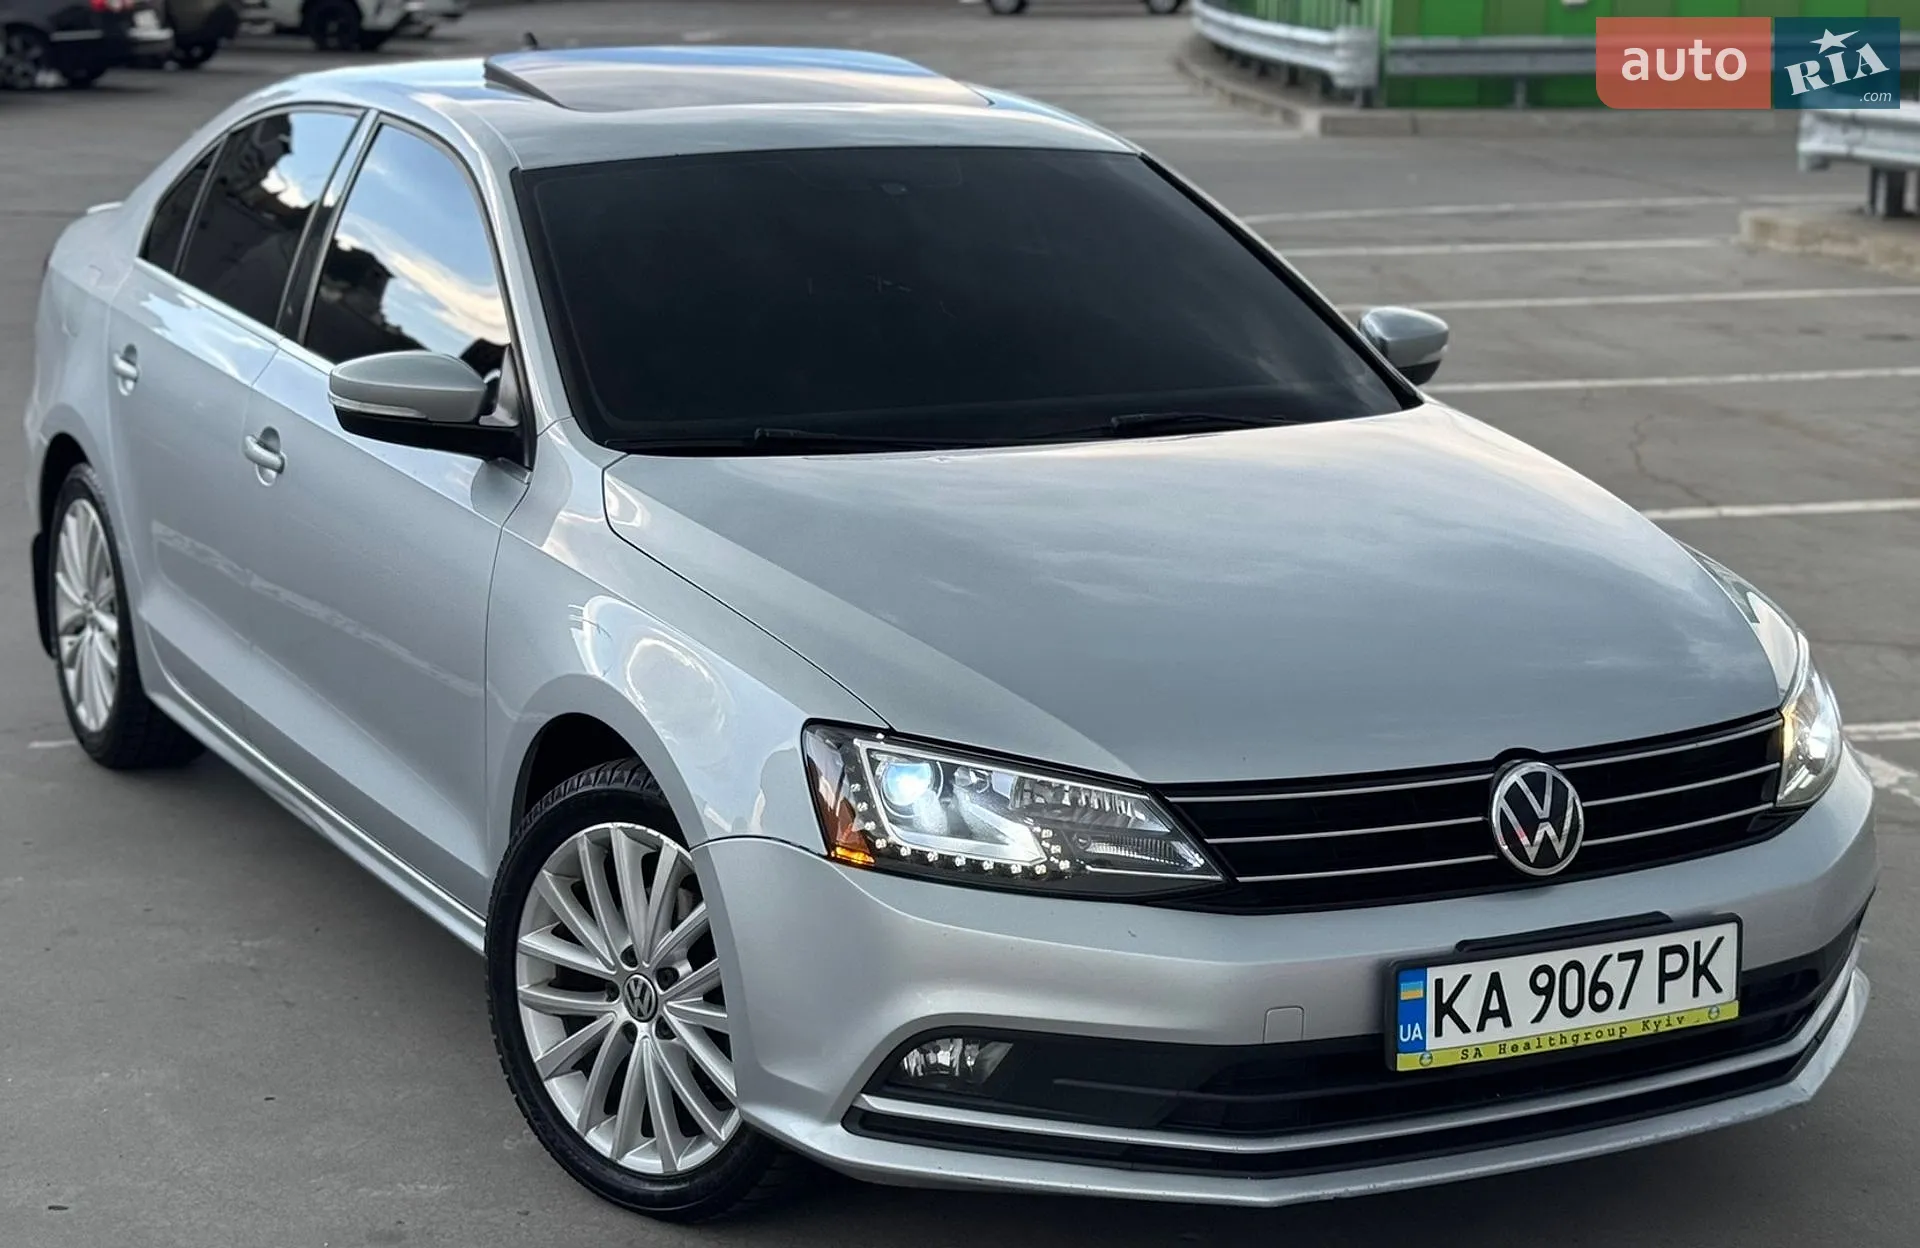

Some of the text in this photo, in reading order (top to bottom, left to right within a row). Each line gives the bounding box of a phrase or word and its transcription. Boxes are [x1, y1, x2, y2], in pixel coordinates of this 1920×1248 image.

[1498, 768, 1576, 865] VW
[1433, 936, 1725, 1038] KA 9067 PK
[1399, 1023, 1423, 1042] UA
[1460, 1015, 1685, 1060] SA Healthgroup Kyiv
